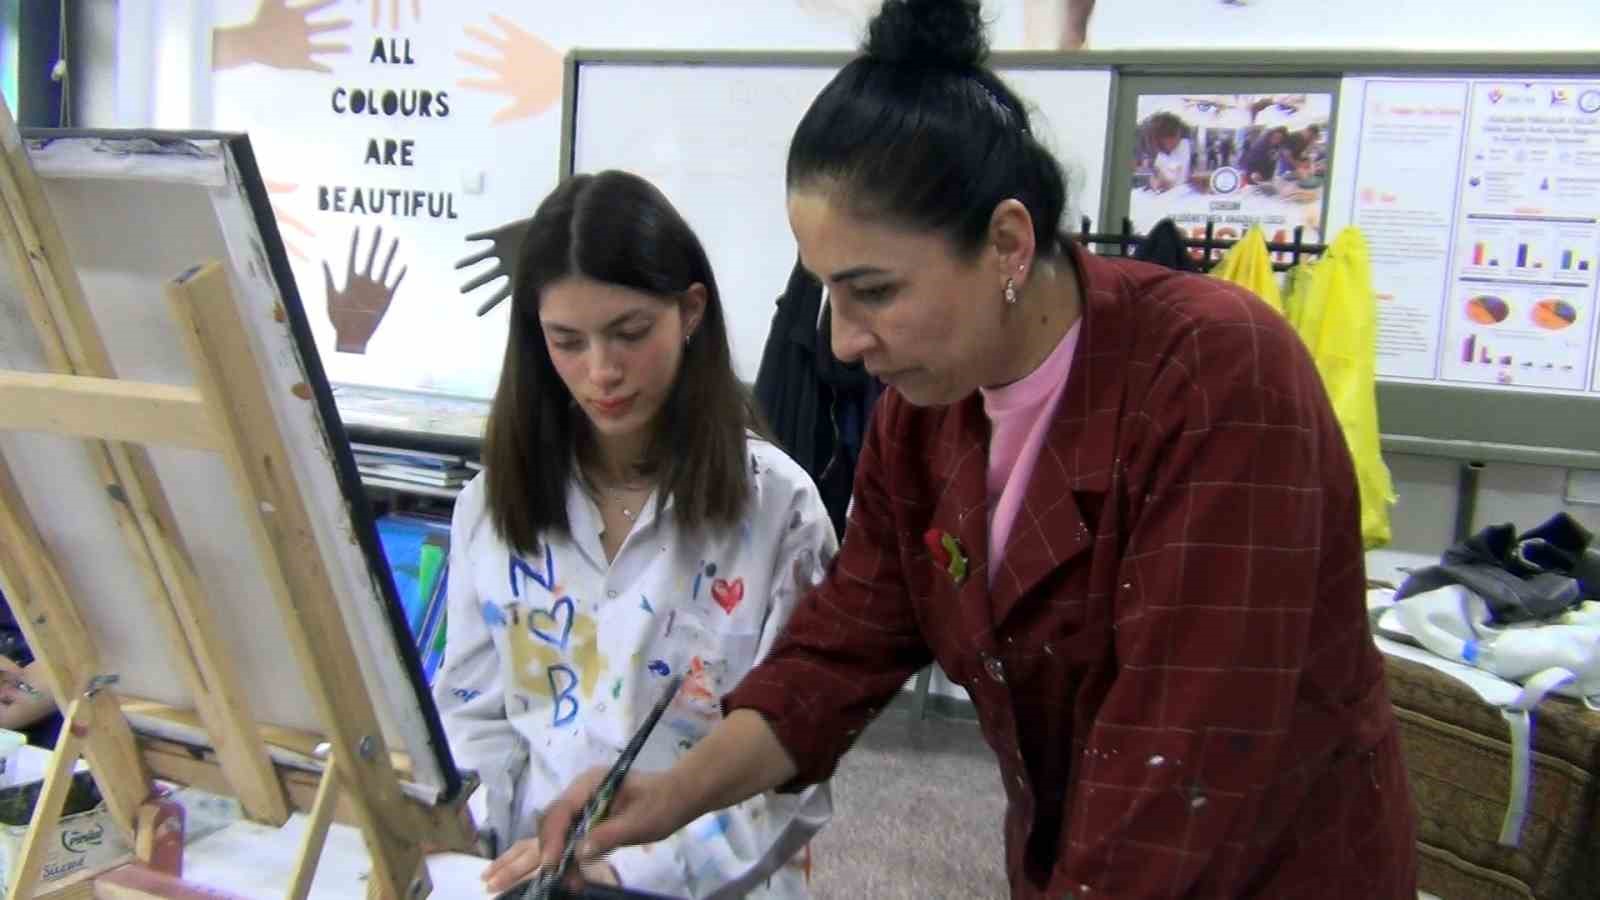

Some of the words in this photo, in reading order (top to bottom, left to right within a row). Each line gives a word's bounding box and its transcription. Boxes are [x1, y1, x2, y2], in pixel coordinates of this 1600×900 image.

[370, 37, 414, 64] ALL
[331, 86, 450, 118] COLOURS
[364, 137, 415, 166] ARE
[317, 185, 458, 219] BEAUTIFUL
[508, 543, 556, 597] N
[547, 663, 579, 727] B
